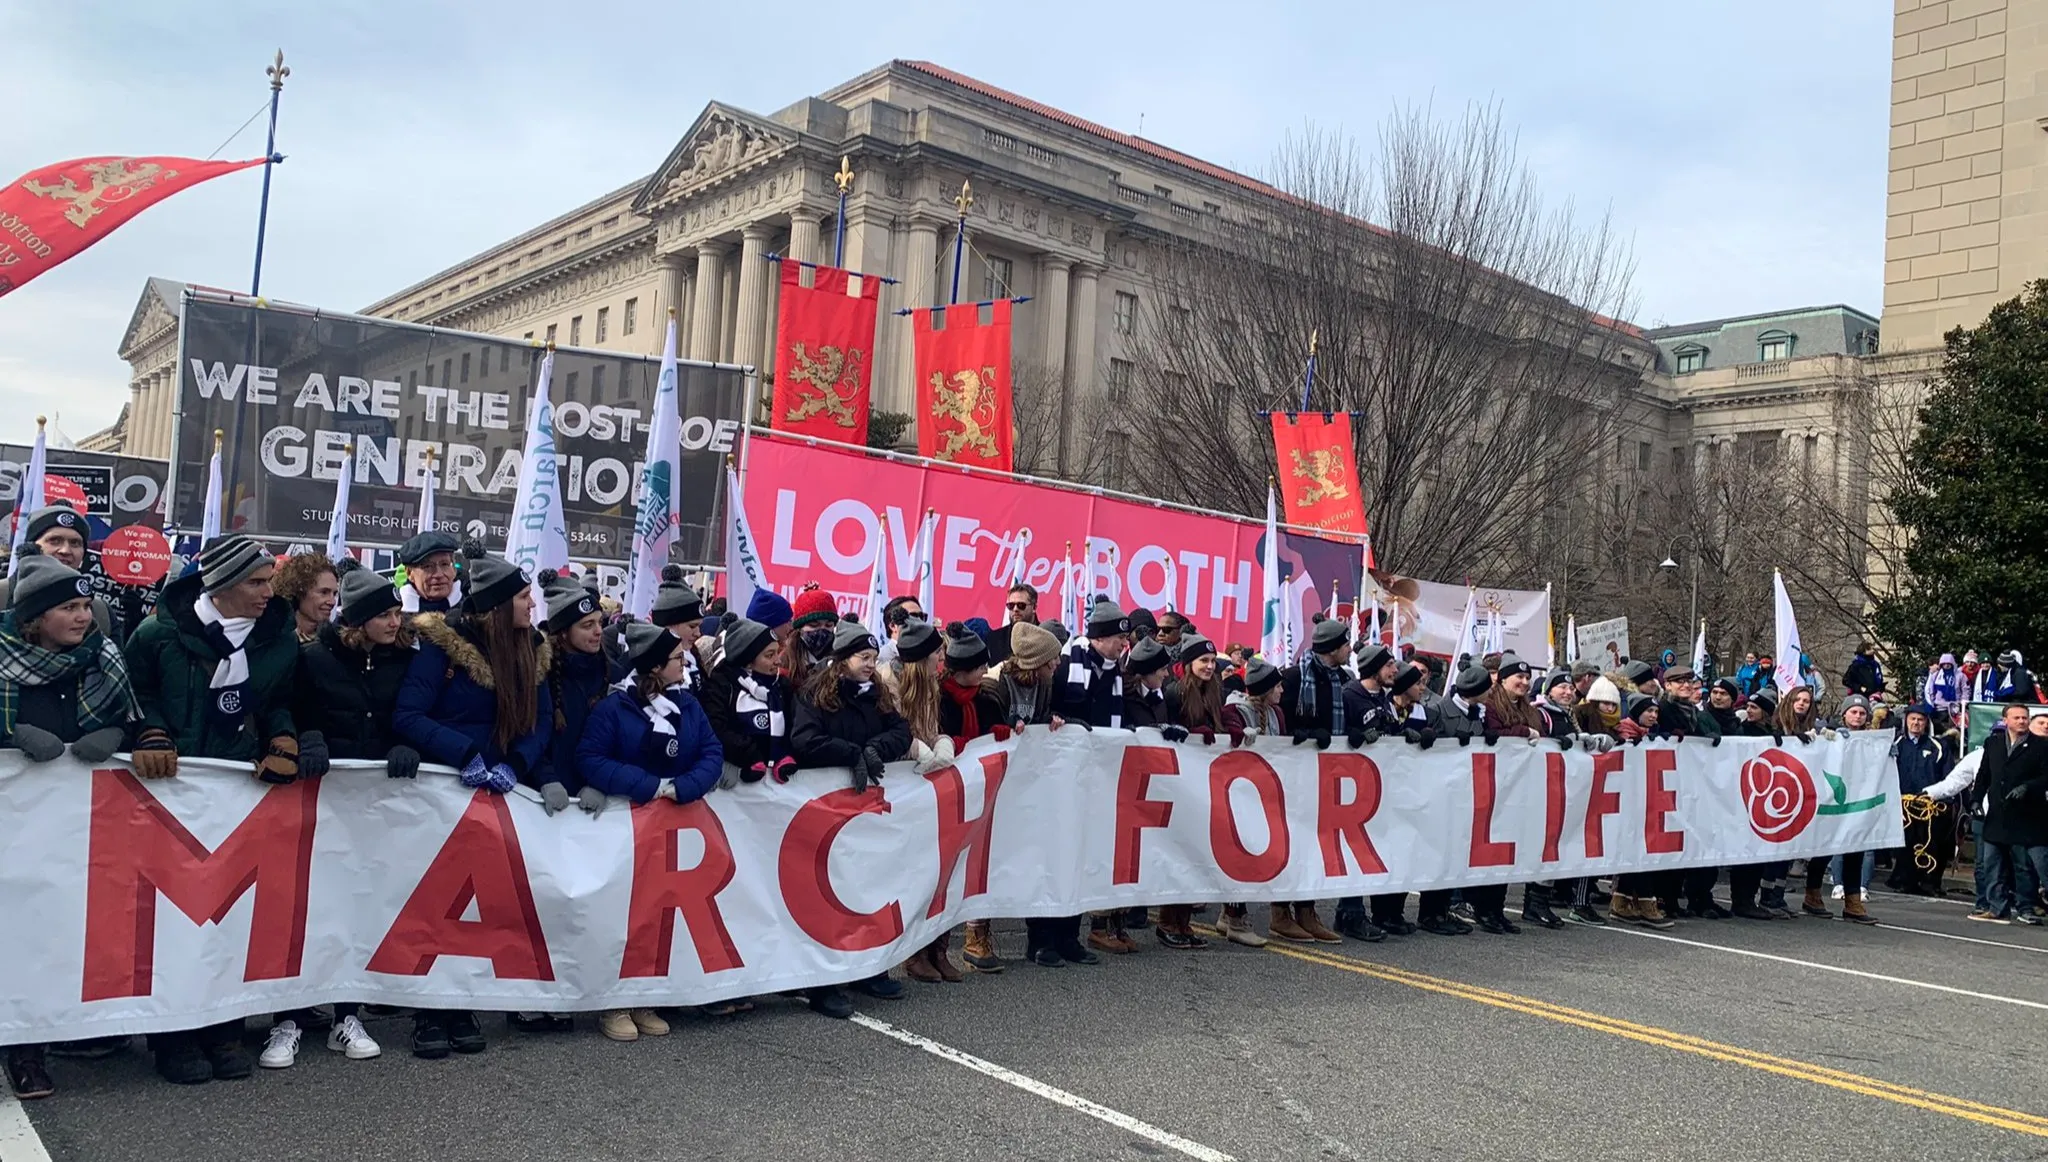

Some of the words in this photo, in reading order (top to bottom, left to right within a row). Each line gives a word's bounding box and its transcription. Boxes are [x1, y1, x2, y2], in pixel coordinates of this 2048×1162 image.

[190, 357, 279, 405] WE
[293, 372, 402, 419] ARE
[417, 385, 510, 430] THE
[525, 397, 740, 453] OST-OE
[260, 425, 646, 506] GENERAIO
[102, 548, 131, 558] EVERY
[133, 550, 171, 561] WOMAN
[124, 529, 138, 538] We
[140, 531, 154, 539] are
[128, 540, 148, 549] FOR
[491, 523, 513, 537] TEX
[570, 530, 608, 544] 53445
[770, 488, 981, 590] LOVE
[971, 525, 1088, 598] them
[1084, 535, 1252, 623] BOTH
[81, 750, 1009, 1002] MARCH
[1112, 744, 1390, 886] FOR
[1468, 749, 1685, 868] LIFE
